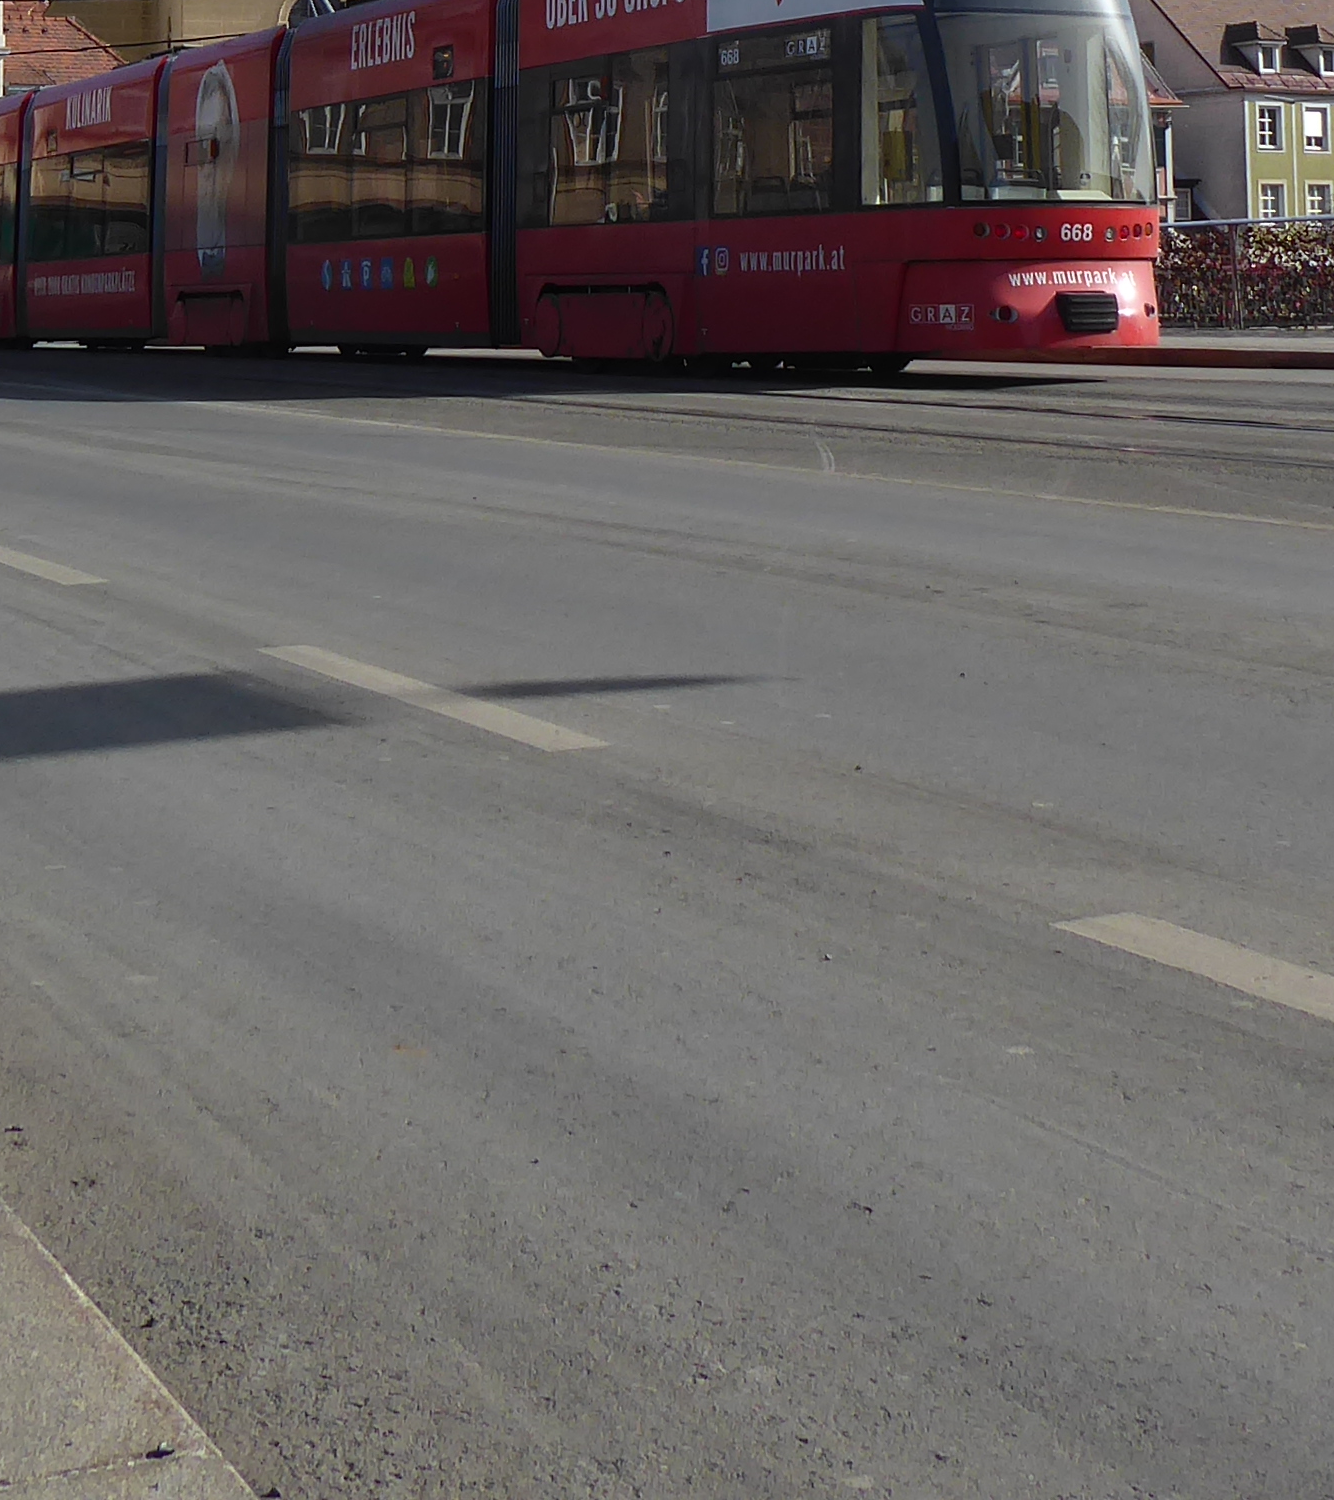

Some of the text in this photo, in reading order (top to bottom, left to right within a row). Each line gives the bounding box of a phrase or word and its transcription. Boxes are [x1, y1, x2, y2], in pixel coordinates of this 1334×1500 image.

[351, 10, 416, 71] ERLEBNIS
[720, 48, 740, 66] 668
[65, 85, 113, 130] KULINARIK
[1060, 223, 1094, 242] 668
[740, 244, 846, 277] www.murpark.at
[1008, 267, 1137, 288] www.murpark.at
[910, 305, 972, 323] GRAZ
